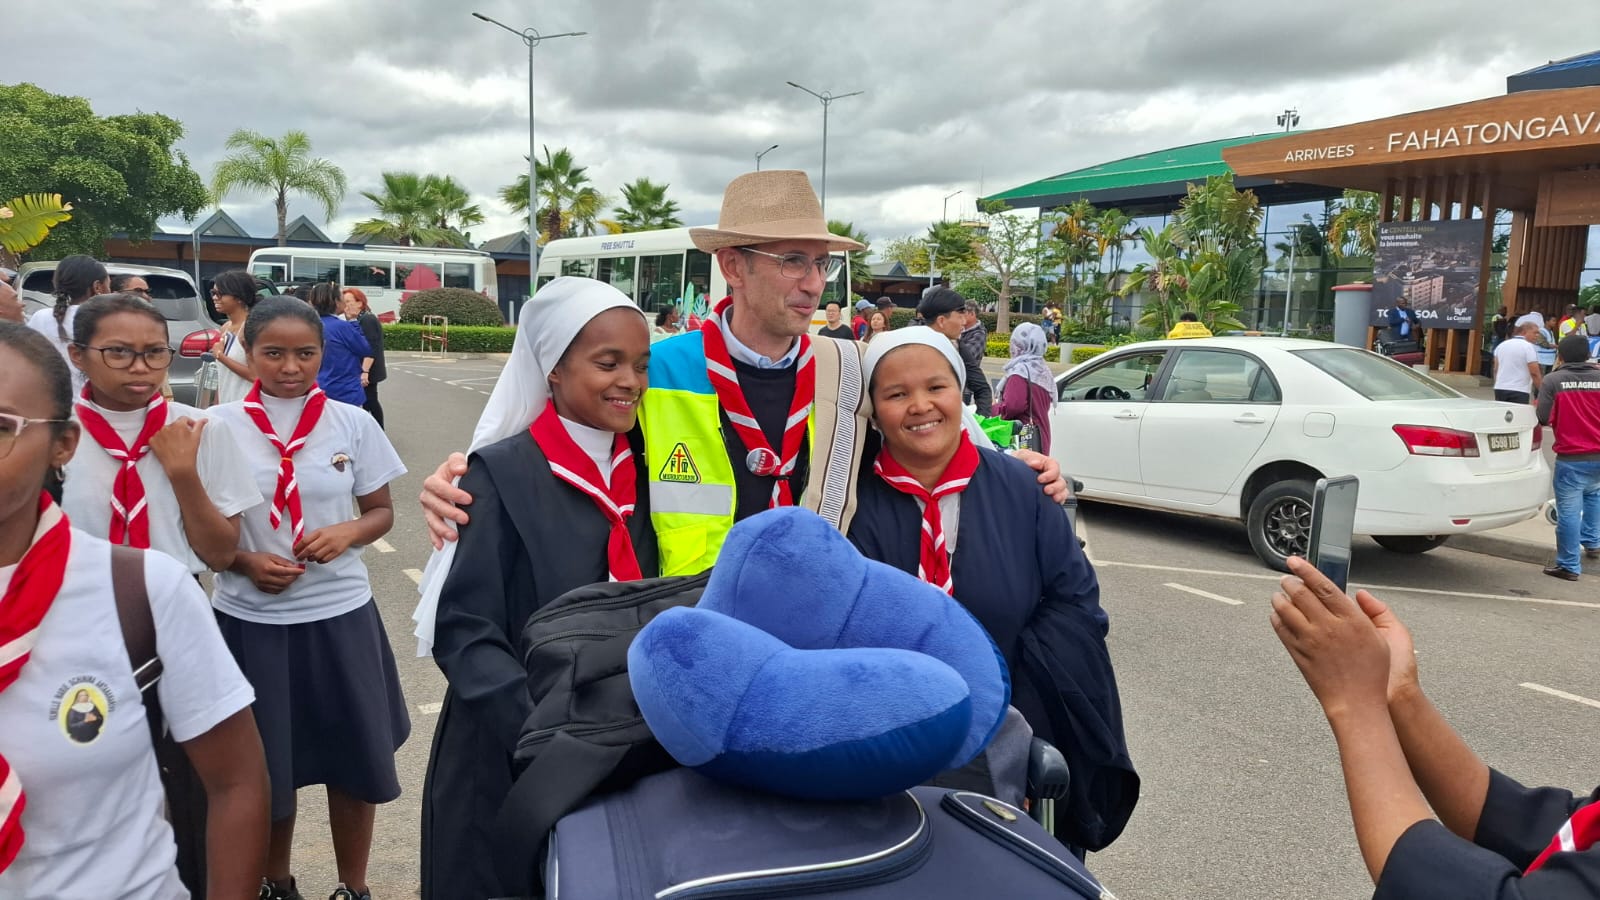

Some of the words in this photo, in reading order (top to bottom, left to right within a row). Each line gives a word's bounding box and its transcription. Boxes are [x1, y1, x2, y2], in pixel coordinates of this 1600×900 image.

[1285, 144, 1355, 163] ARRIVEES
[601, 242, 612, 250] FREE
[612, 240, 635, 249] SHUTTLE
[1560, 381, 1577, 389] TAXI
